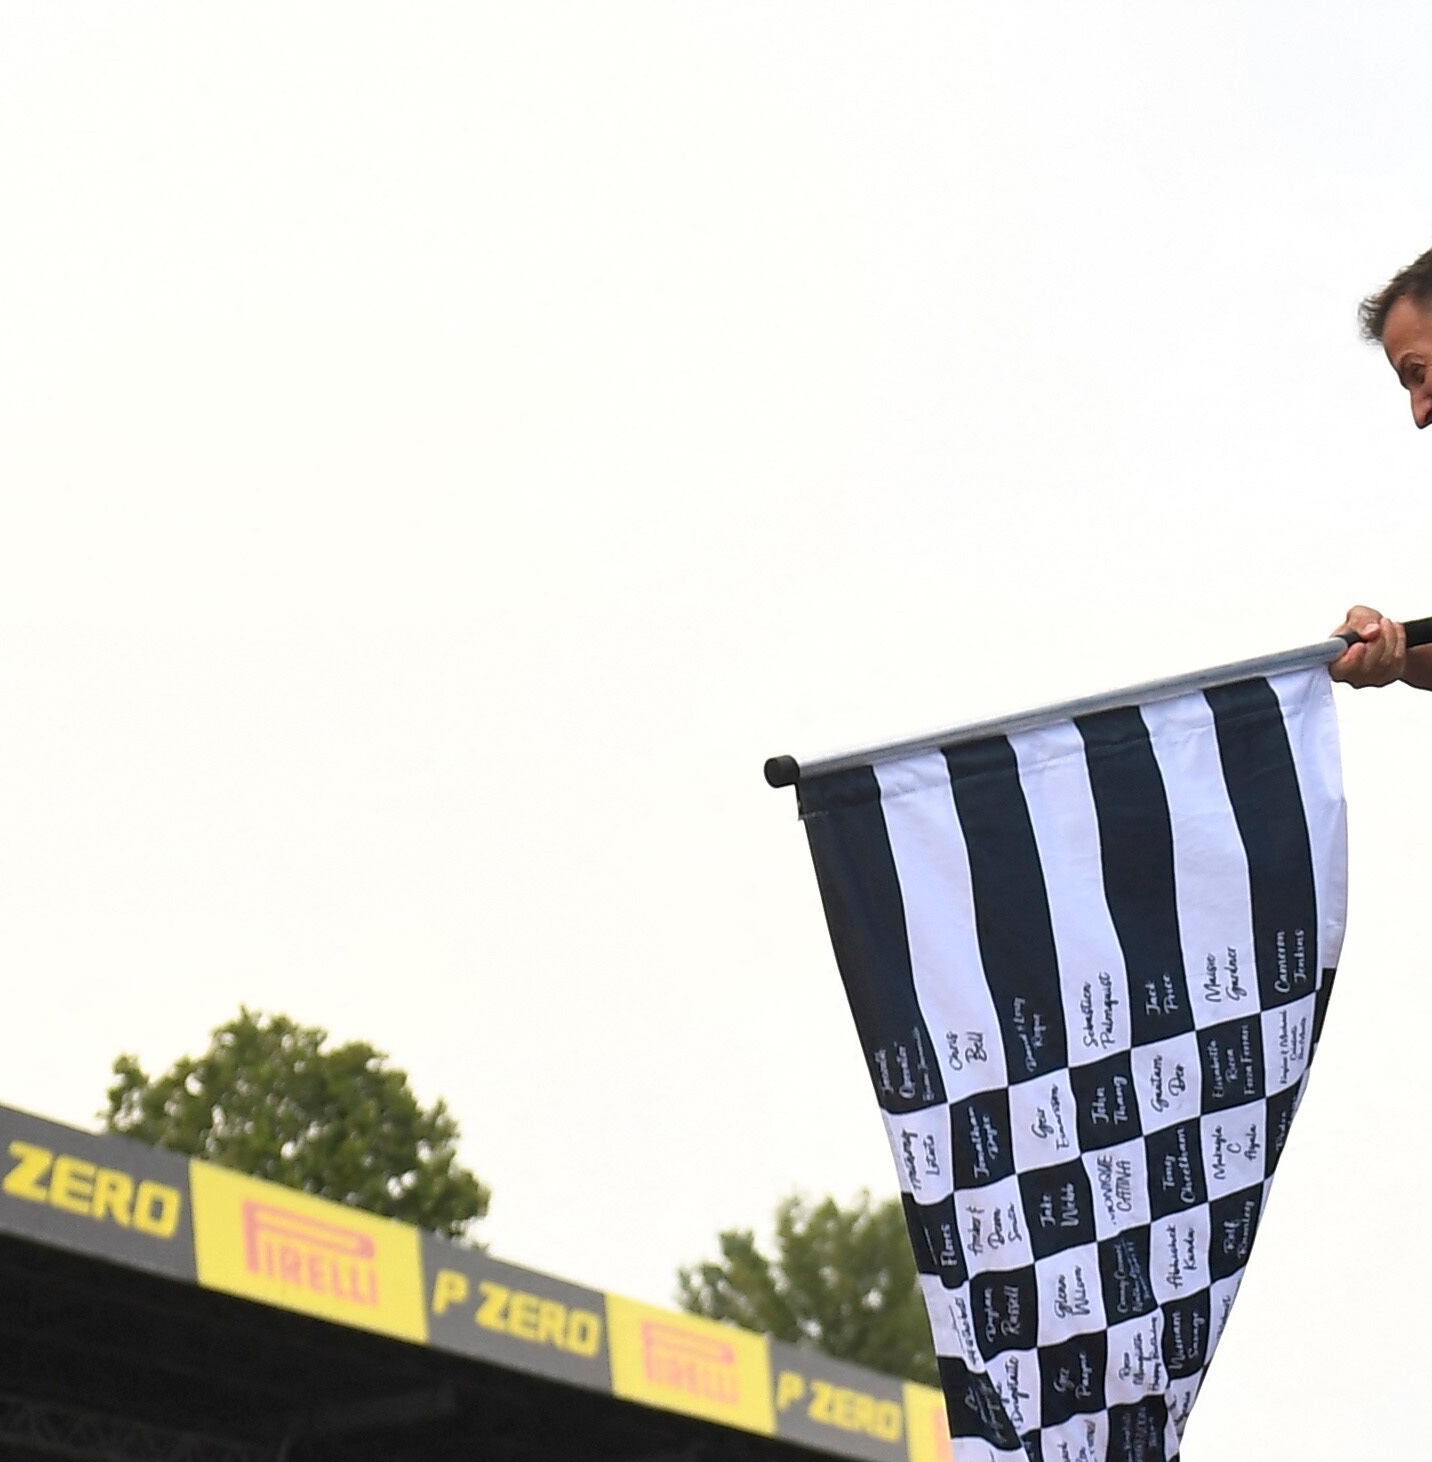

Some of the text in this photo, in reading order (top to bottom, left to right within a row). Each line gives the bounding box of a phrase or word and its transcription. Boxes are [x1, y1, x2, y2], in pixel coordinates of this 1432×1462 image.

[1274, 930, 1290, 993] Cameron
[1293, 929, 1307, 984] Jenkins
[945, 1031, 963, 1071] Chris
[965, 1032, 988, 1063] Bell
[1091, 1086, 1110, 1125] John
[2, 1141, 182, 1239] ZERO
[241, 1198, 381, 1307] PIRELLI
[432, 1267, 605, 1358] P ZERO
[776, 1370, 807, 1411] P
[809, 1379, 903, 1444] ZERO
